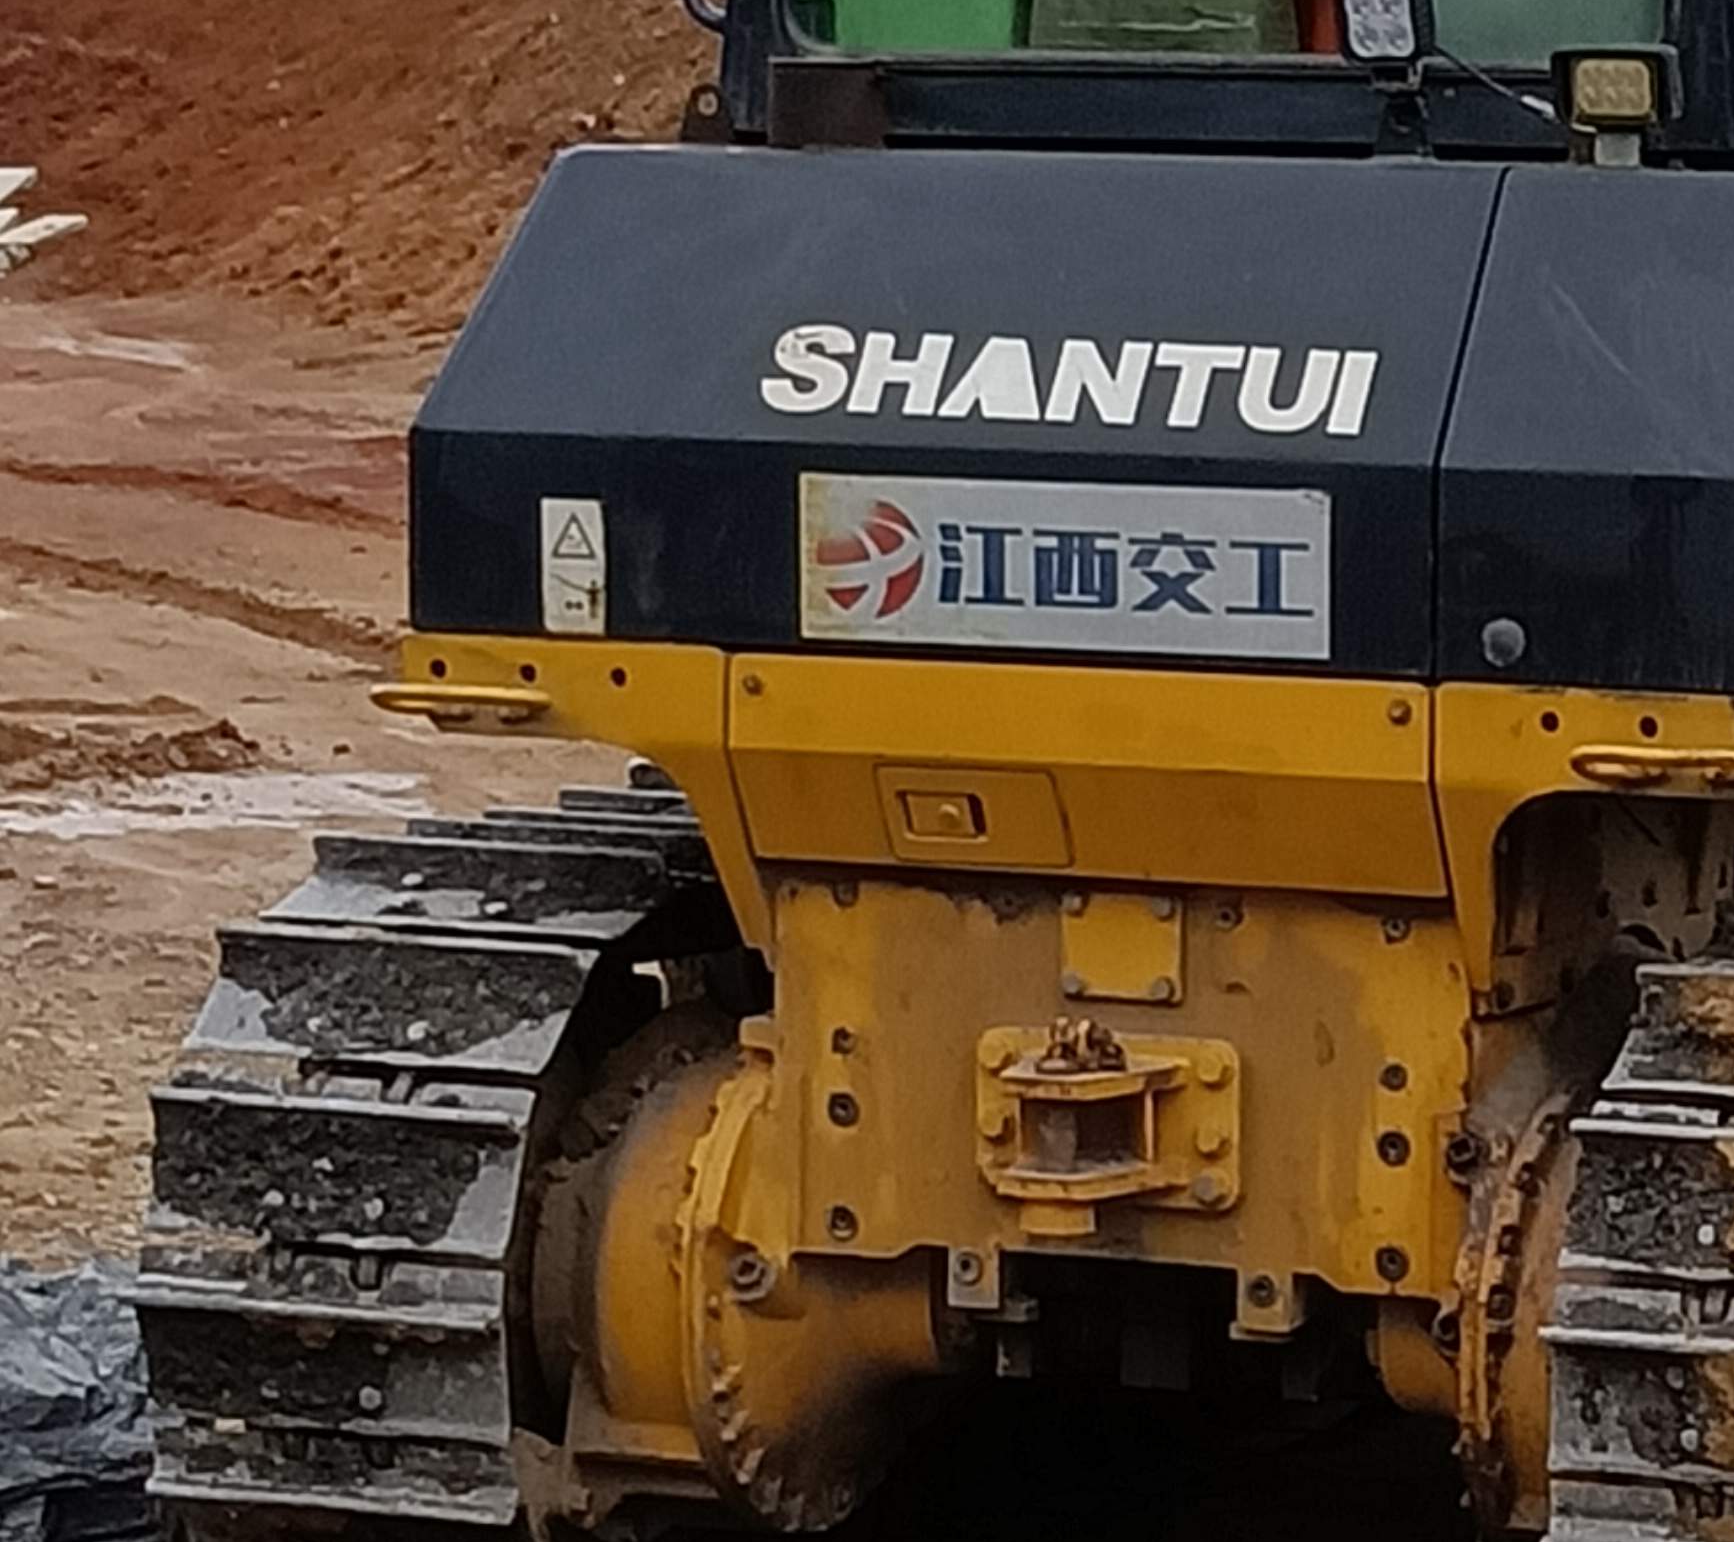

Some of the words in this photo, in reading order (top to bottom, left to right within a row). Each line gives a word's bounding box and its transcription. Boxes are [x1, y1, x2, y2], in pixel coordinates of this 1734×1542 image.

[761, 325, 1378, 436] SHANTUI
[938, 522, 1314, 619] 江西交工
